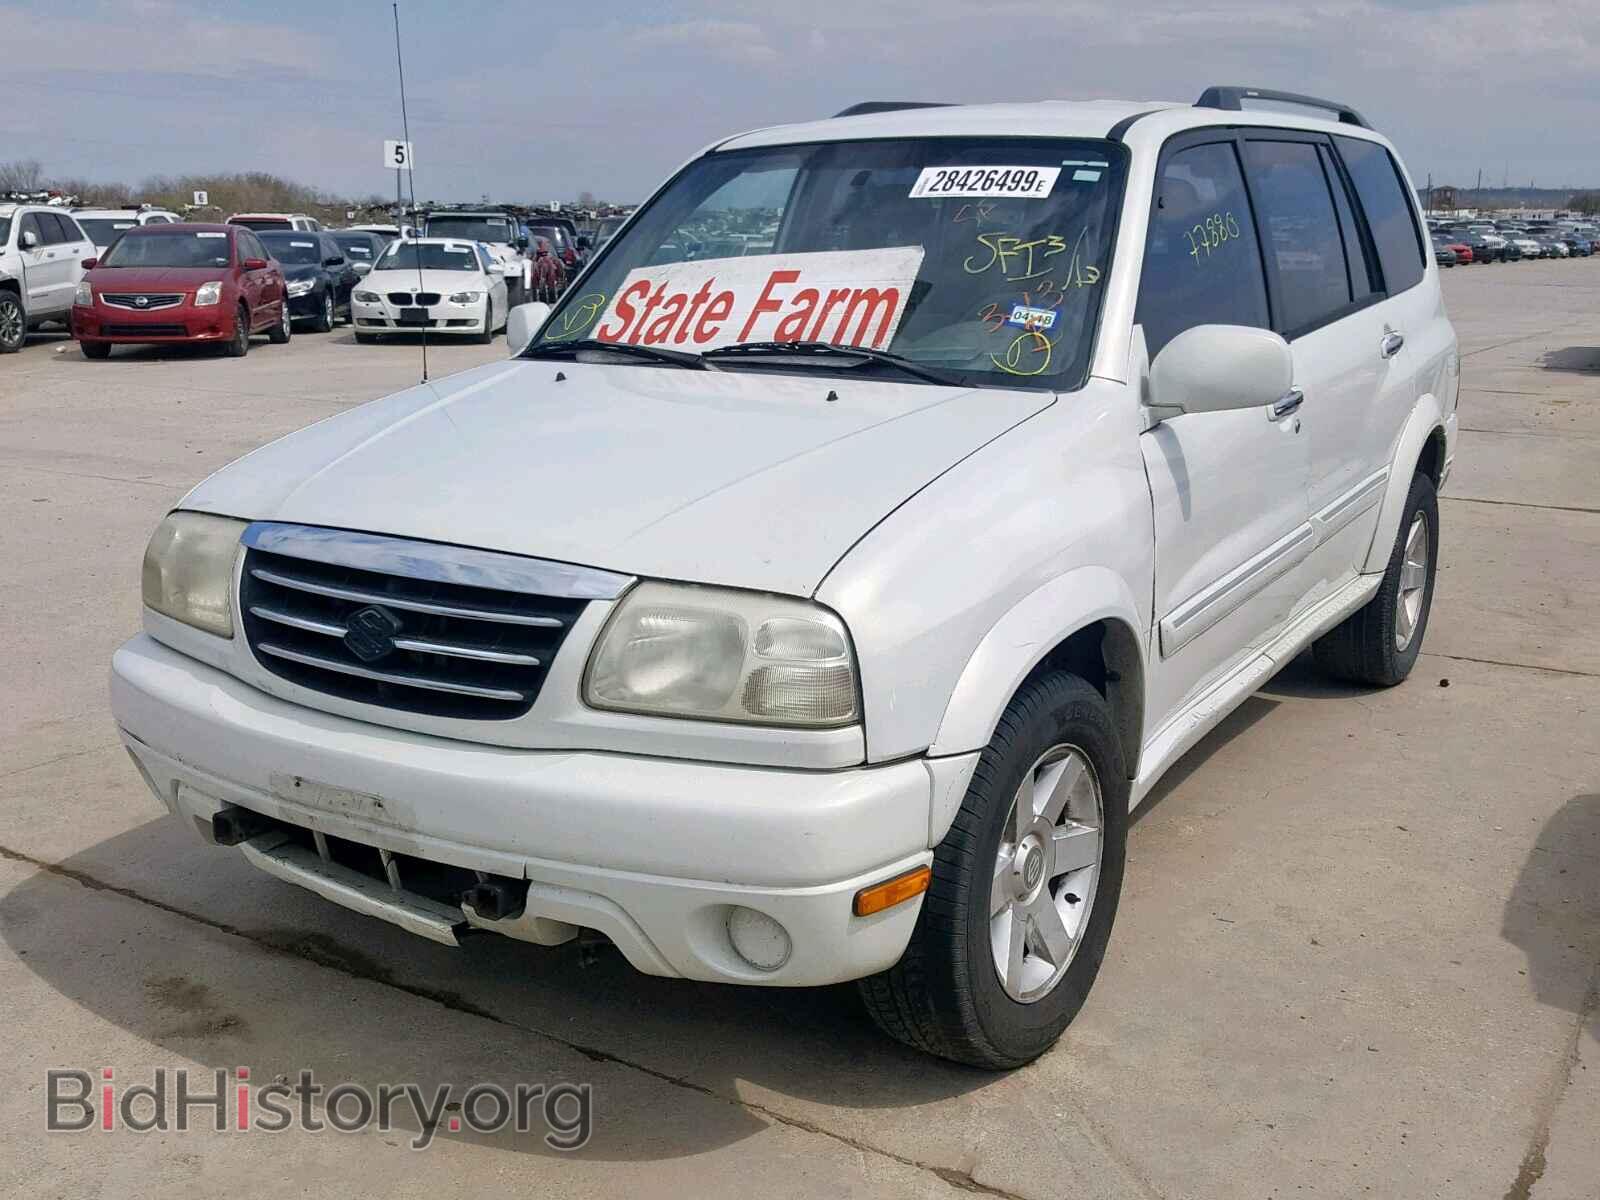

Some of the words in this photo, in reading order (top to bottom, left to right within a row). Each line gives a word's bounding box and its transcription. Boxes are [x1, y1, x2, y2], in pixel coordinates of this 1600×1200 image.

[395, 145, 404, 164] 5
[599, 277, 735, 345] State
[736, 270, 900, 352] Farm
